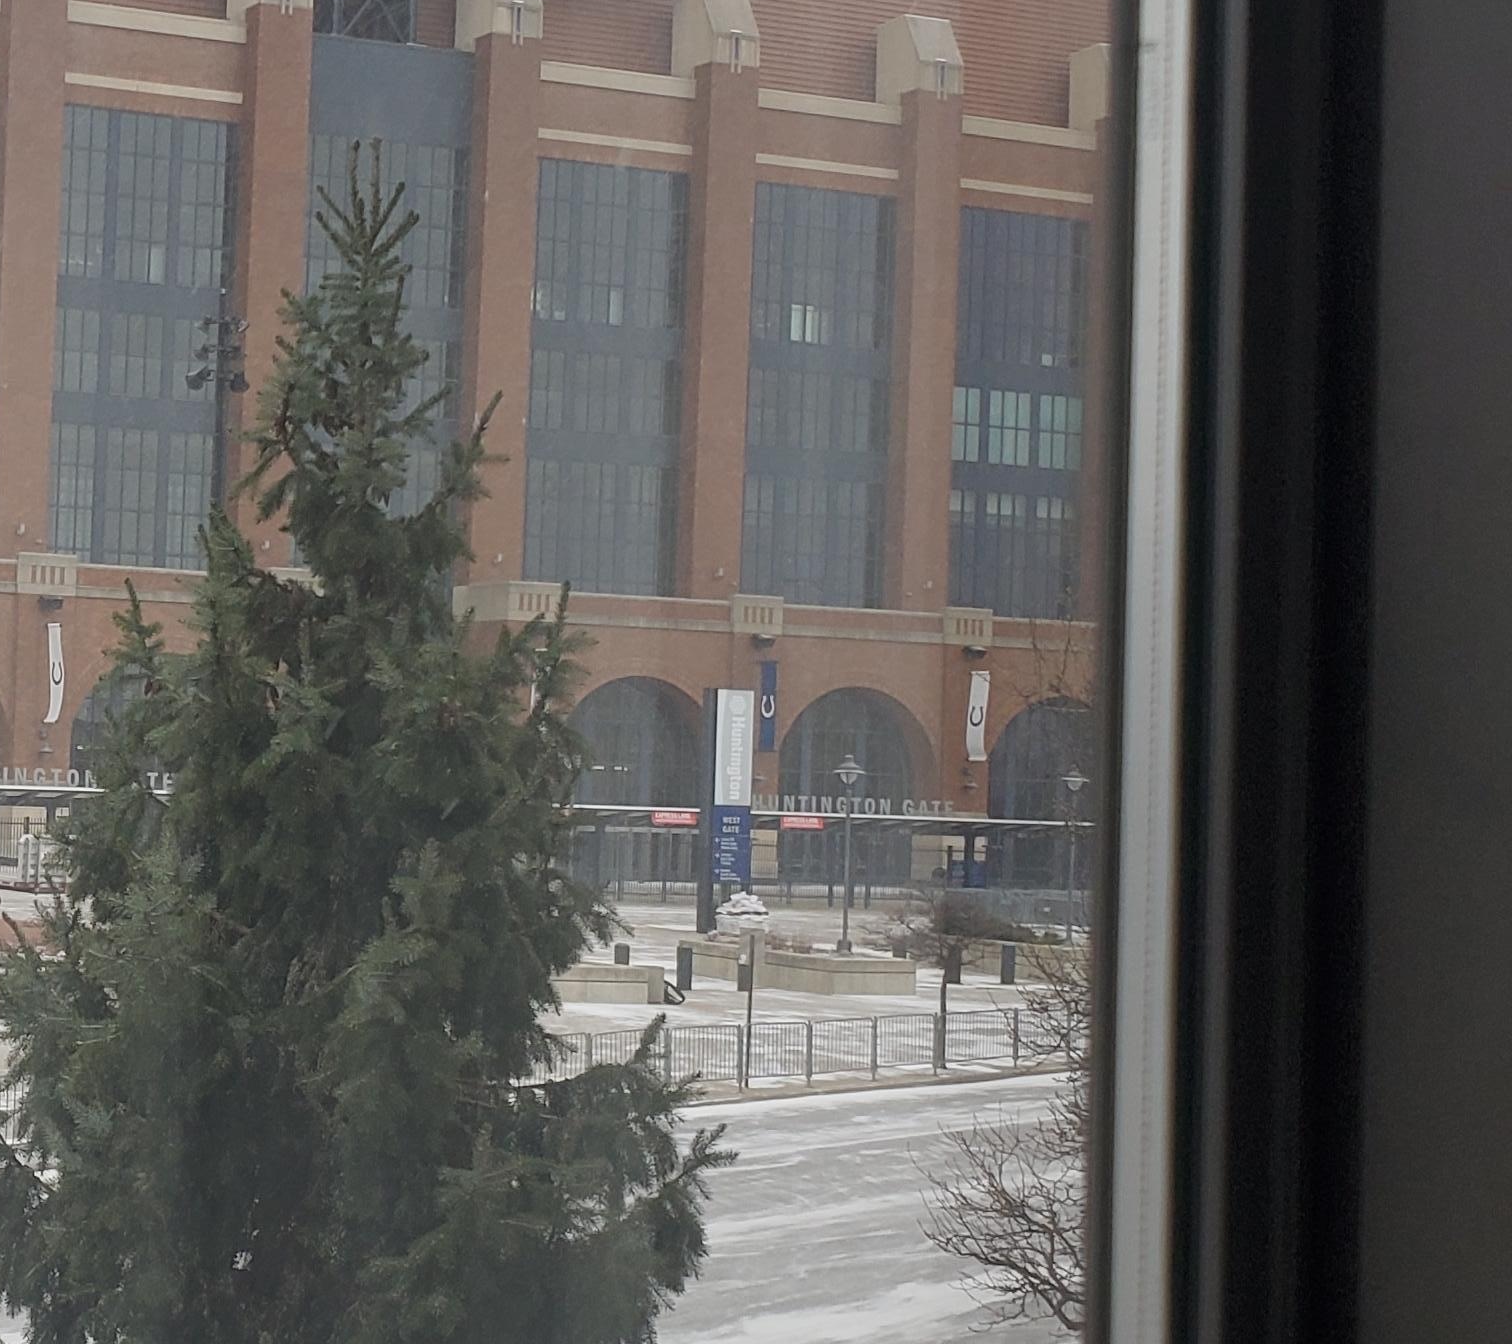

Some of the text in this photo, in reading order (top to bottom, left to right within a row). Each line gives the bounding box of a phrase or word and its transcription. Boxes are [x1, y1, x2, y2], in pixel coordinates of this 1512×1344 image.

[727, 716, 747, 801] Huntington
[751, 793, 955, 817] HUNTINGTON GATE
[722, 816, 741, 824] WEST
[722, 825, 739, 834] GATE
